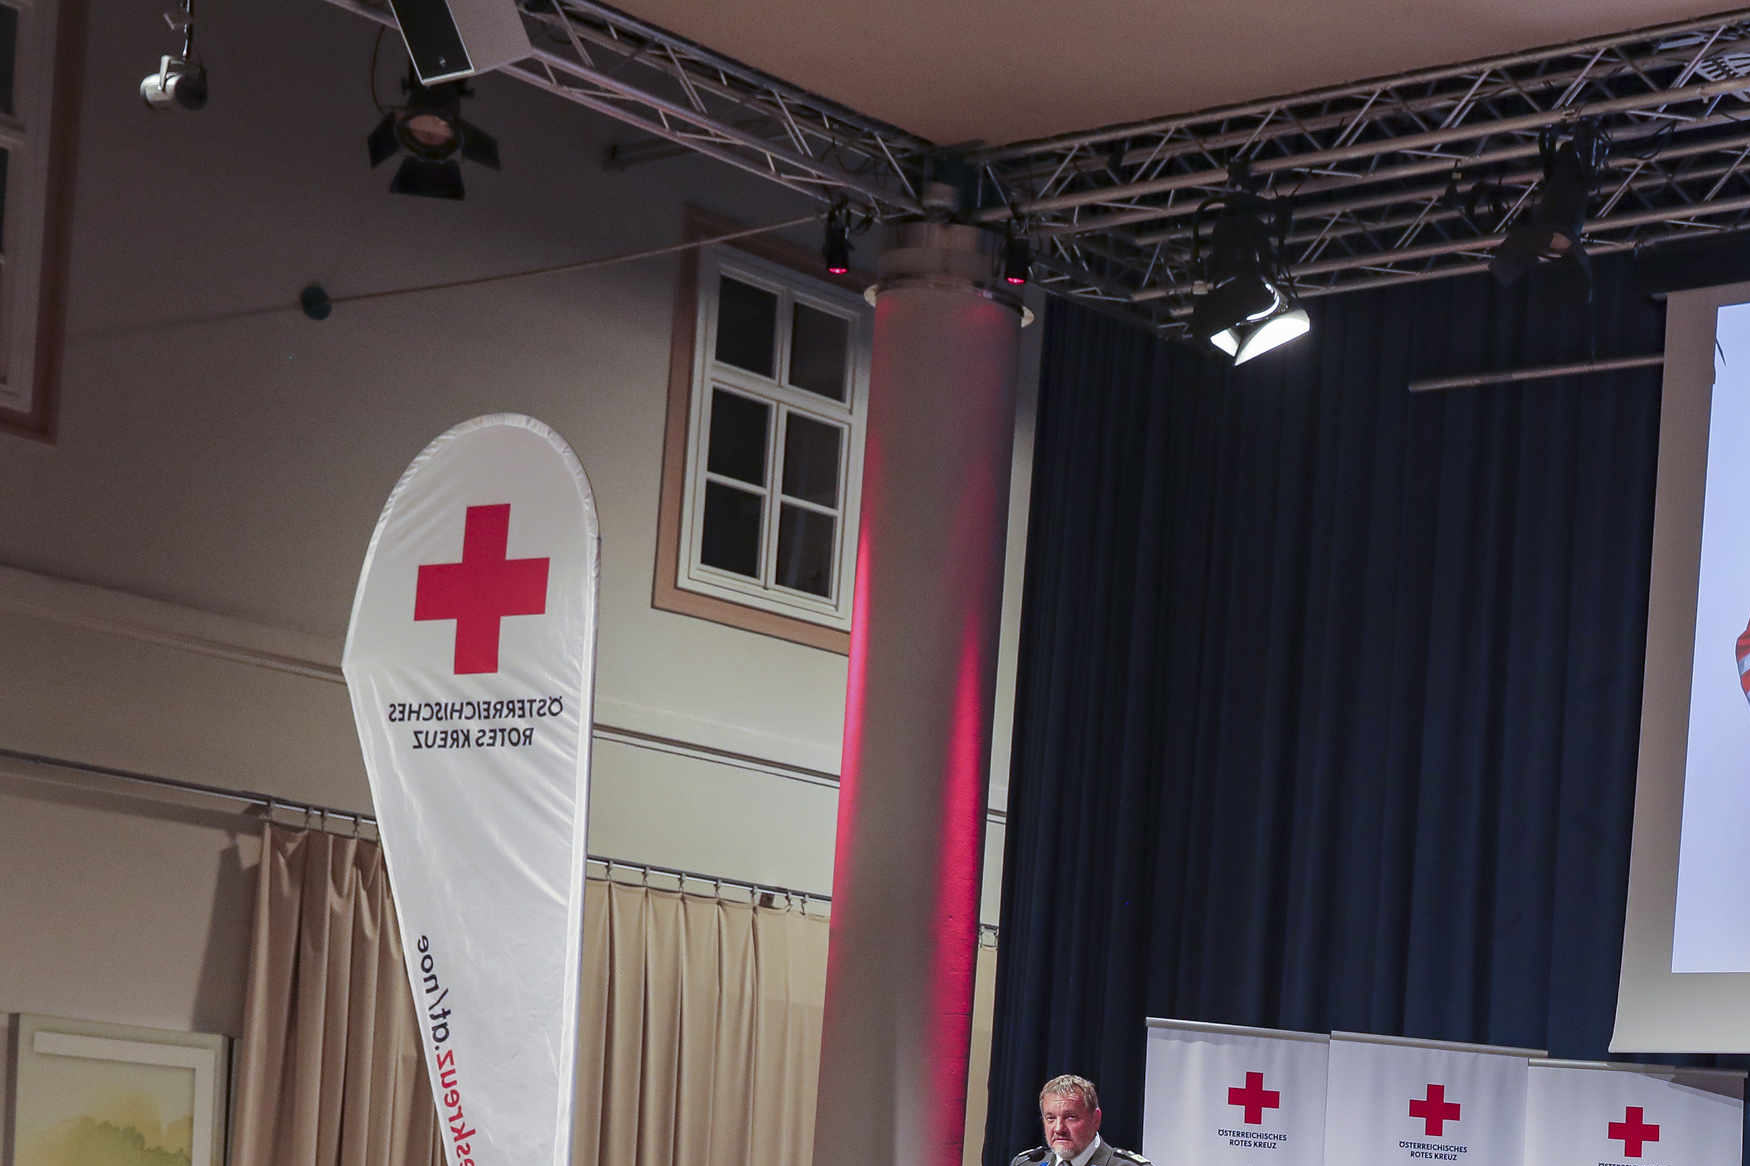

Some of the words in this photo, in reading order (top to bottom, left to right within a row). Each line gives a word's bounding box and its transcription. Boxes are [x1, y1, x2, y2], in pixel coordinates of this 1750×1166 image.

[1217, 1128, 1287, 1141] ÖSTERREICHISCHES
[1229, 1139, 1252, 1147] ROTES
[1253, 1141, 1277, 1149] KREUZ
[1398, 1140, 1468, 1153] ÖSTERREICHISCHES
[1410, 1150, 1433, 1159] ROTES
[1434, 1152, 1458, 1161] KREUZ
